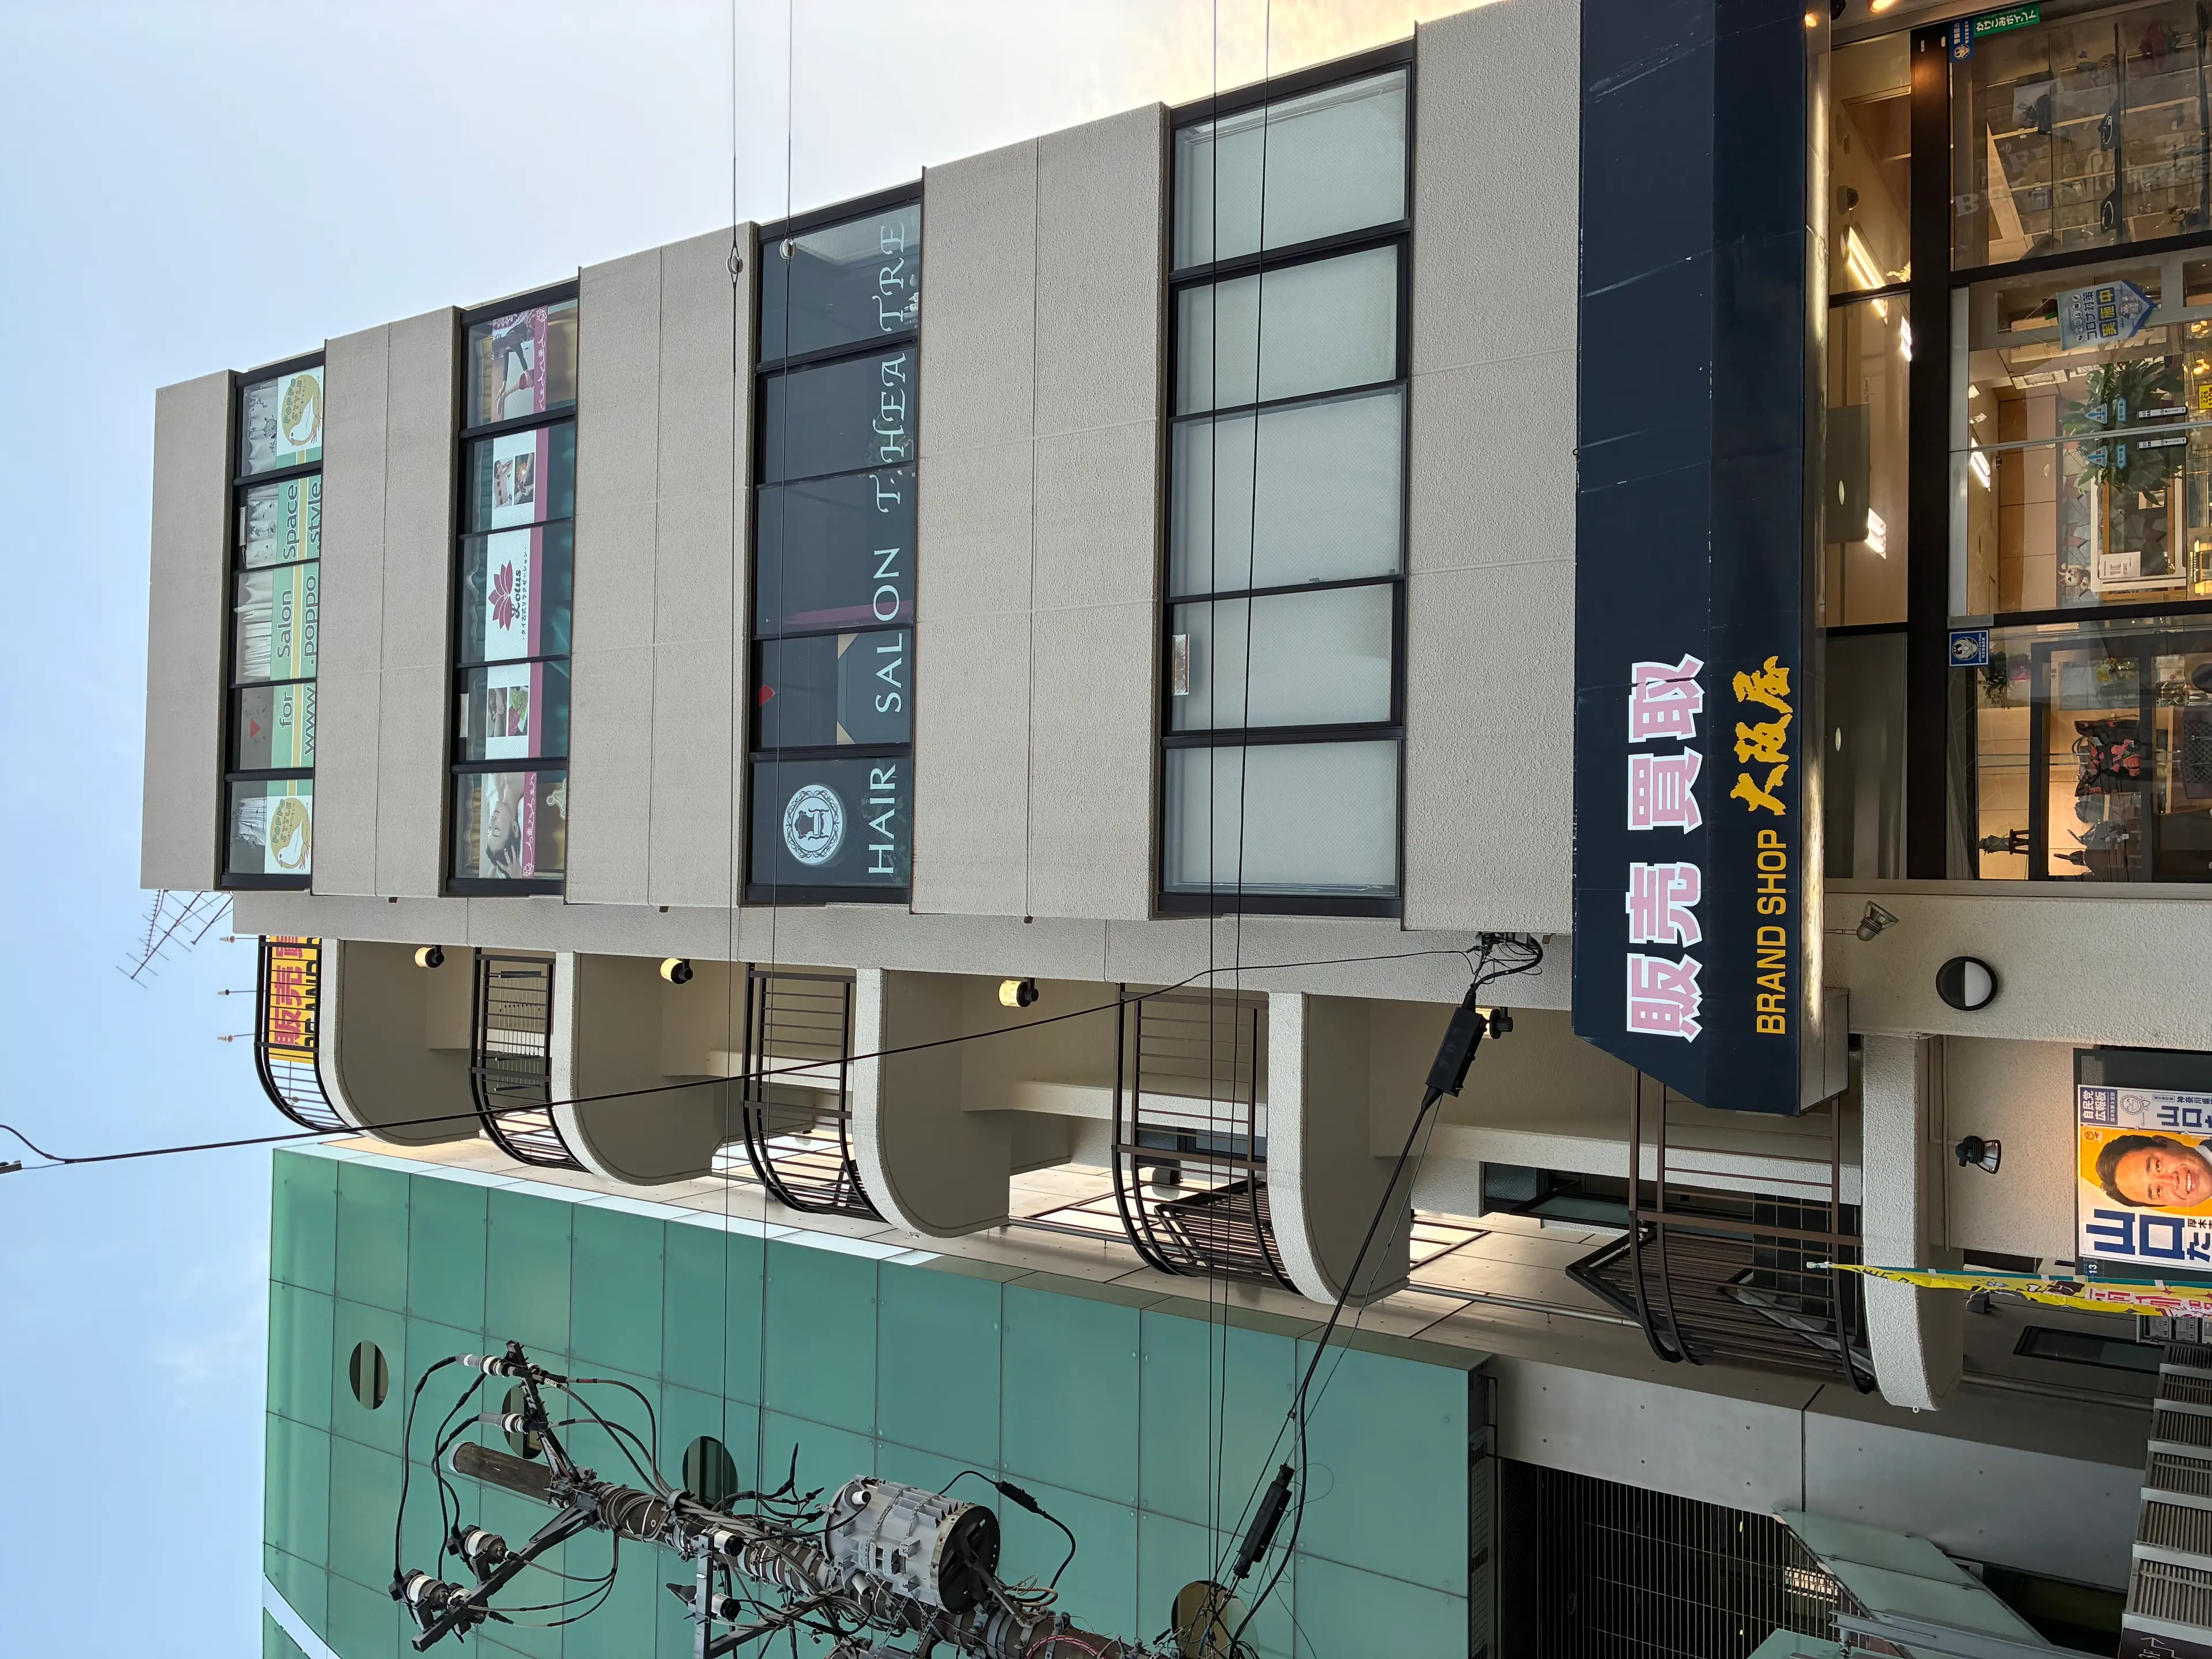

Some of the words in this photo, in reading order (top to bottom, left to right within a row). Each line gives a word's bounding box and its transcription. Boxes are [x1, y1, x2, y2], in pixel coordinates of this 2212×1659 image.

[1976, 10, 2037, 32] かけこみポイント
[2082, 291, 2097, 340] コロナ対策
[2099, 289, 2117, 337] 実施中
[869, 221, 907, 513] THEATRE
[283, 378, 296, 423] POPPO
[282, 484, 300, 560] Space
[277, 589, 293, 659] Salon
[511, 569, 521, 619] Lotus
[873, 547, 903, 713] SALON
[278, 691, 293, 728] for
[1730, 655, 1793, 816] 大阪屋
[1627, 653, 1705, 834] 買取
[272, 799, 285, 844] POPPO
[281, 801, 291, 842] STYLE
[868, 763, 896, 874] HAIR
[1756, 828, 1787, 916] SHOP
[1625, 861, 1703, 1043] 販売
[1756, 925, 1787, 1035] BRAND
[274, 965, 302, 1046] 販売
[2082, 1090, 2094, 1119] 自民党
[2094, 1091, 2107, 1122] 広報板
[2088, 1264, 2097, 1274] 13
